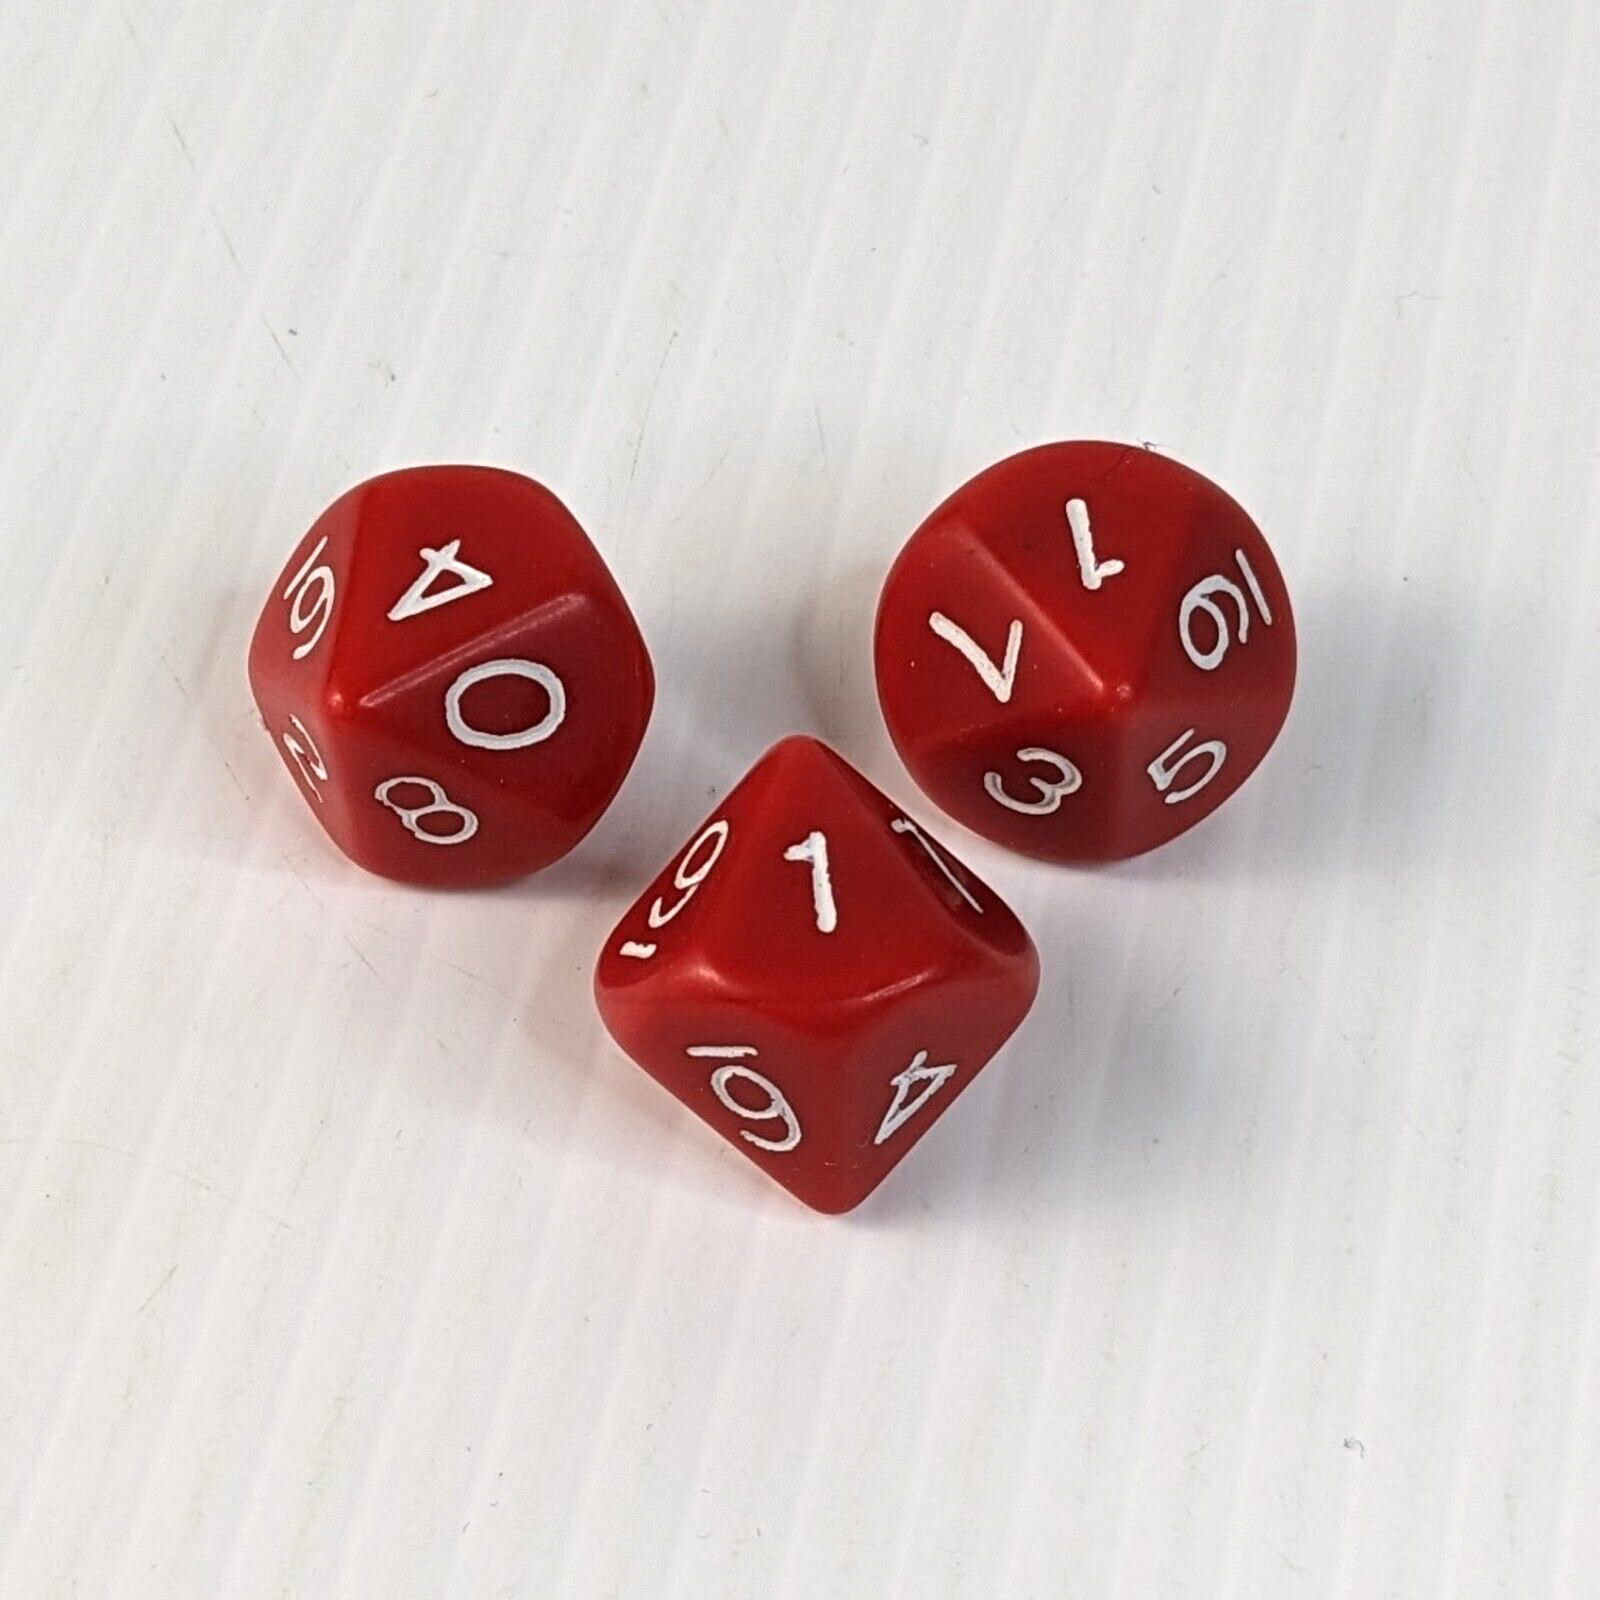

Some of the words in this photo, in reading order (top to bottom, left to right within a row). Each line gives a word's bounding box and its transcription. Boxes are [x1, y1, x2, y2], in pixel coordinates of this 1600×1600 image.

[387, 539, 494, 621] 4
[1066, 498, 1125, 590] 1
[283, 535, 336, 660] 6
[1178, 548, 1273, 671] 9
[928, 611, 1023, 703] 7
[444, 658, 566, 750] 0
[284, 713, 329, 804] 2
[983, 747, 1082, 815] 3
[1147, 728, 1227, 804] 5
[374, 776, 479, 845] 8
[619, 819, 729, 959] 9
[783, 831, 838, 933] 1
[686, 1046, 802, 1152] 6
[874, 1050, 957, 1145] 4
